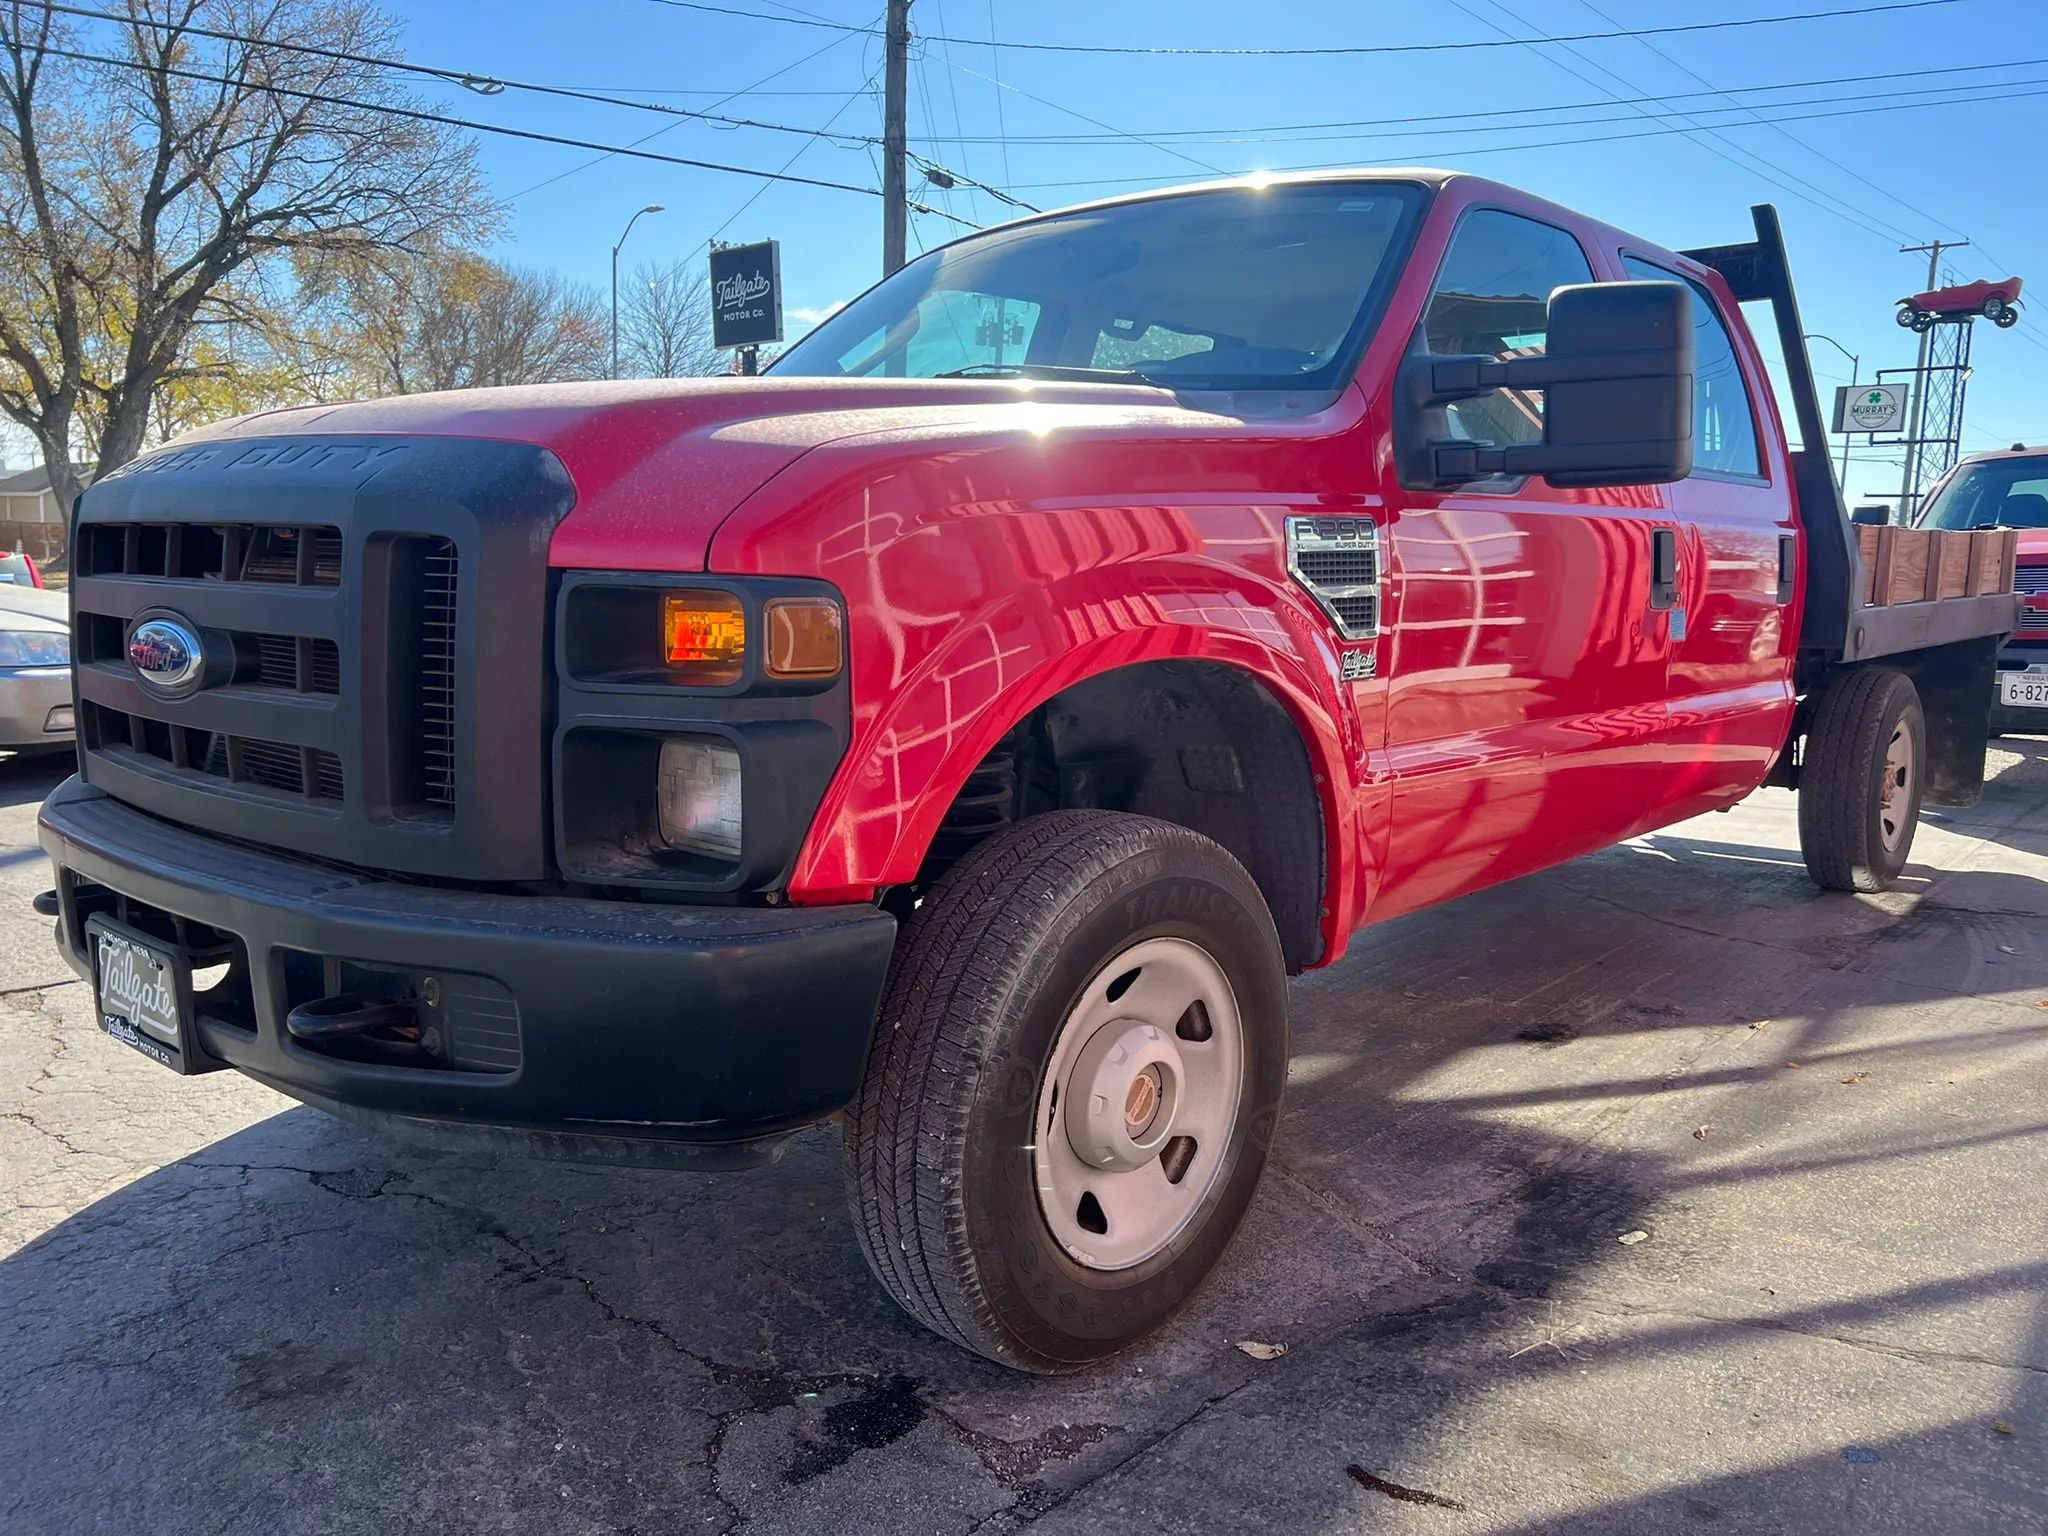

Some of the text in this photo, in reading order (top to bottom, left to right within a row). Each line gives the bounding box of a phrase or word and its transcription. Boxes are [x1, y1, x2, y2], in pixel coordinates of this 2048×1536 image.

[716, 270, 770, 309] Tailgate
[723, 310, 750, 321] MOTOR
[1852, 405, 1896, 415] MURRAY'S
[224, 445, 409, 470] DUTY
[1335, 541, 1375, 549] SUPER DUTY
[99, 943, 178, 1034] Tailgate
[105, 1015, 138, 1045] Tailgate
[139, 1040, 160, 1059] MOTOR
